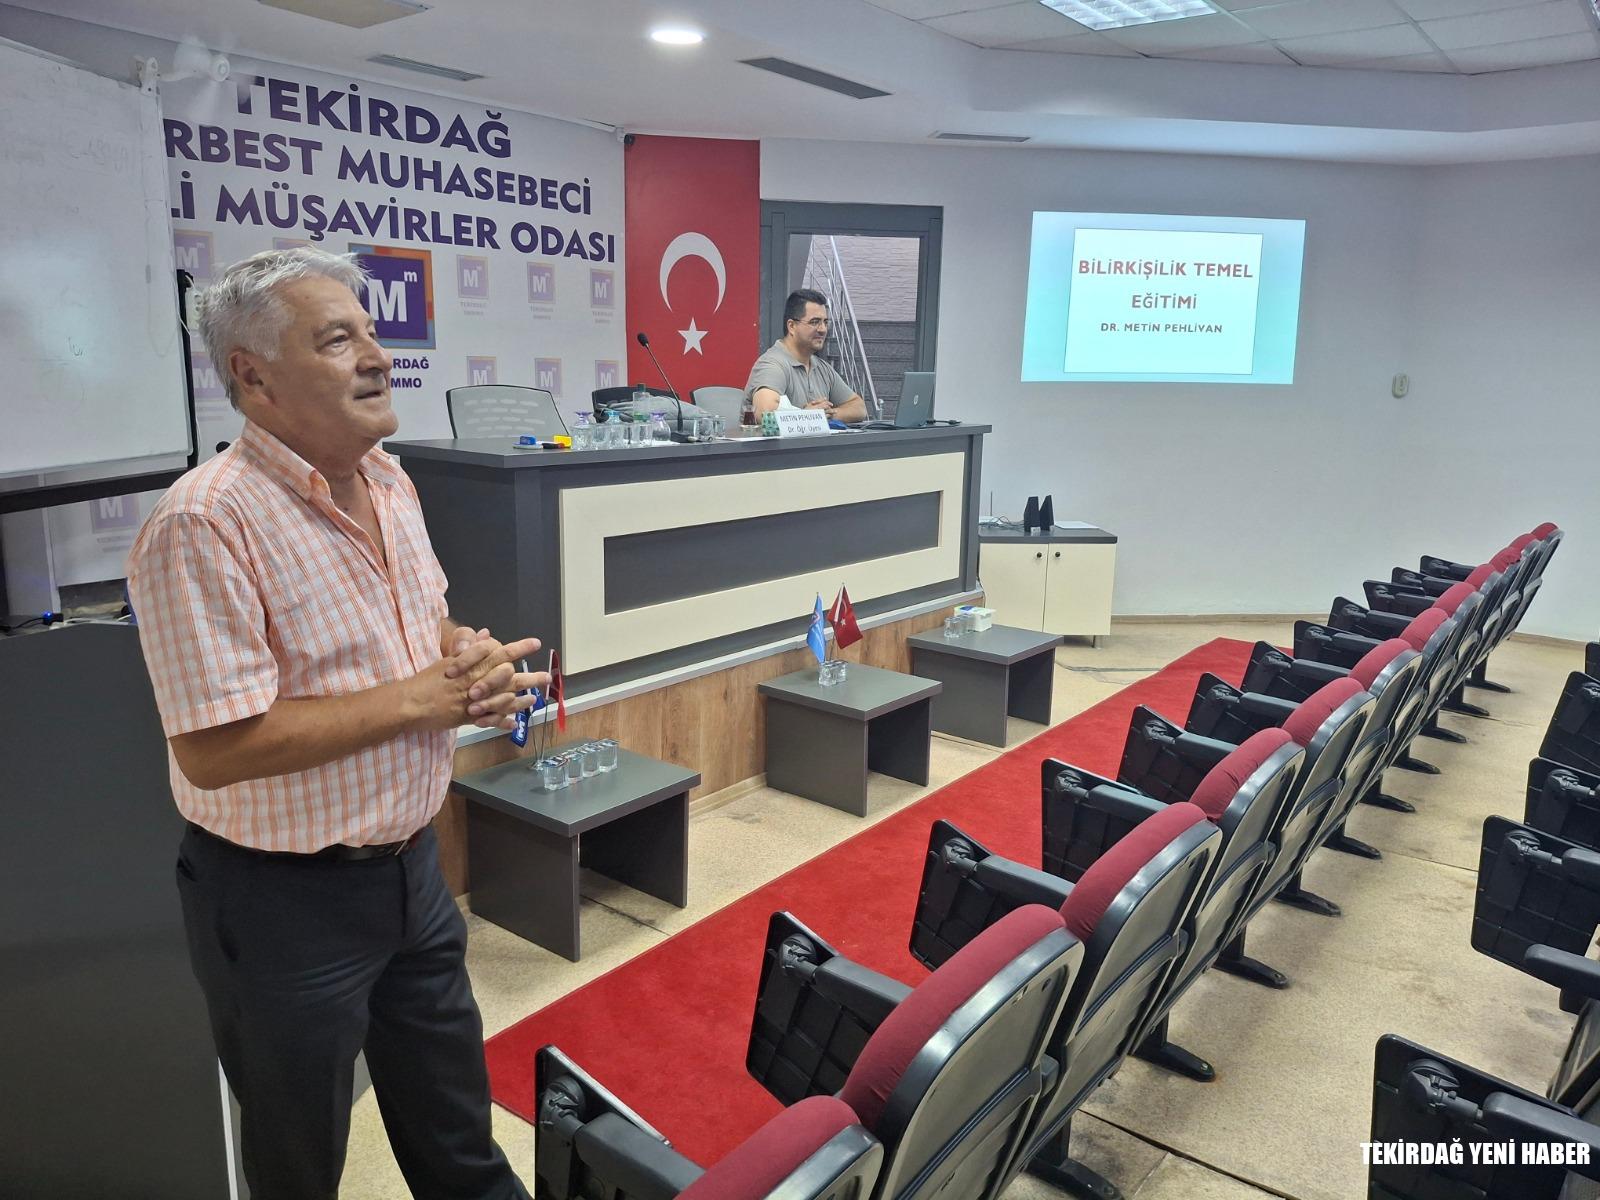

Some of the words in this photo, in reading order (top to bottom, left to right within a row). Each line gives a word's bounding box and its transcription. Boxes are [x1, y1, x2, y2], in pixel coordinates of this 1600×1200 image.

[236, 76, 512, 158] TEKİRDAĞ
[337, 144, 591, 215] MUHASEBECİ
[216, 182, 501, 250] MÜŞAVİRLER
[510, 221, 615, 263] ODASI
[1078, 258, 1187, 280] BİLİRKİŞİLİK
[1193, 262, 1253, 278] TEMEL
[1131, 293, 1197, 309] EĞİTİMİ
[1100, 322, 1120, 332] DR.
[1124, 321, 1160, 333] METİN
[1164, 321, 1223, 333] PEHLİVAN
